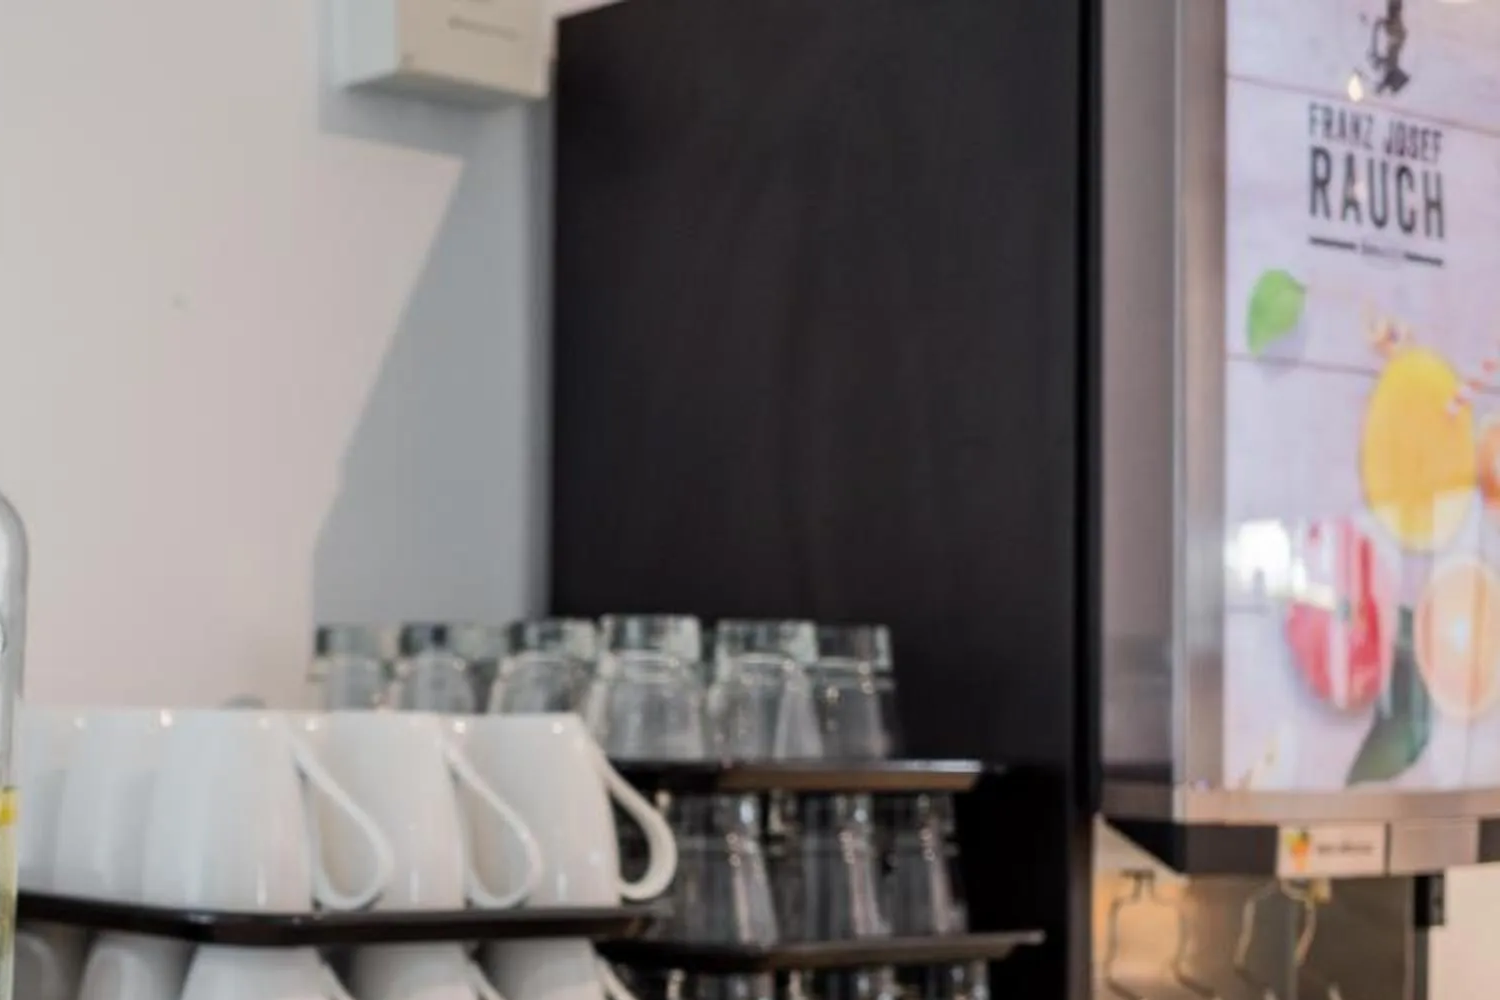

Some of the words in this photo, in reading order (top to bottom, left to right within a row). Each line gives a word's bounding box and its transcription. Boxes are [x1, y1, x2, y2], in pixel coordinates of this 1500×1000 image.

[1308, 102, 1374, 150] FRANZ
[1384, 118, 1443, 165] JOSEF
[1308, 145, 1445, 239] RAUCH
